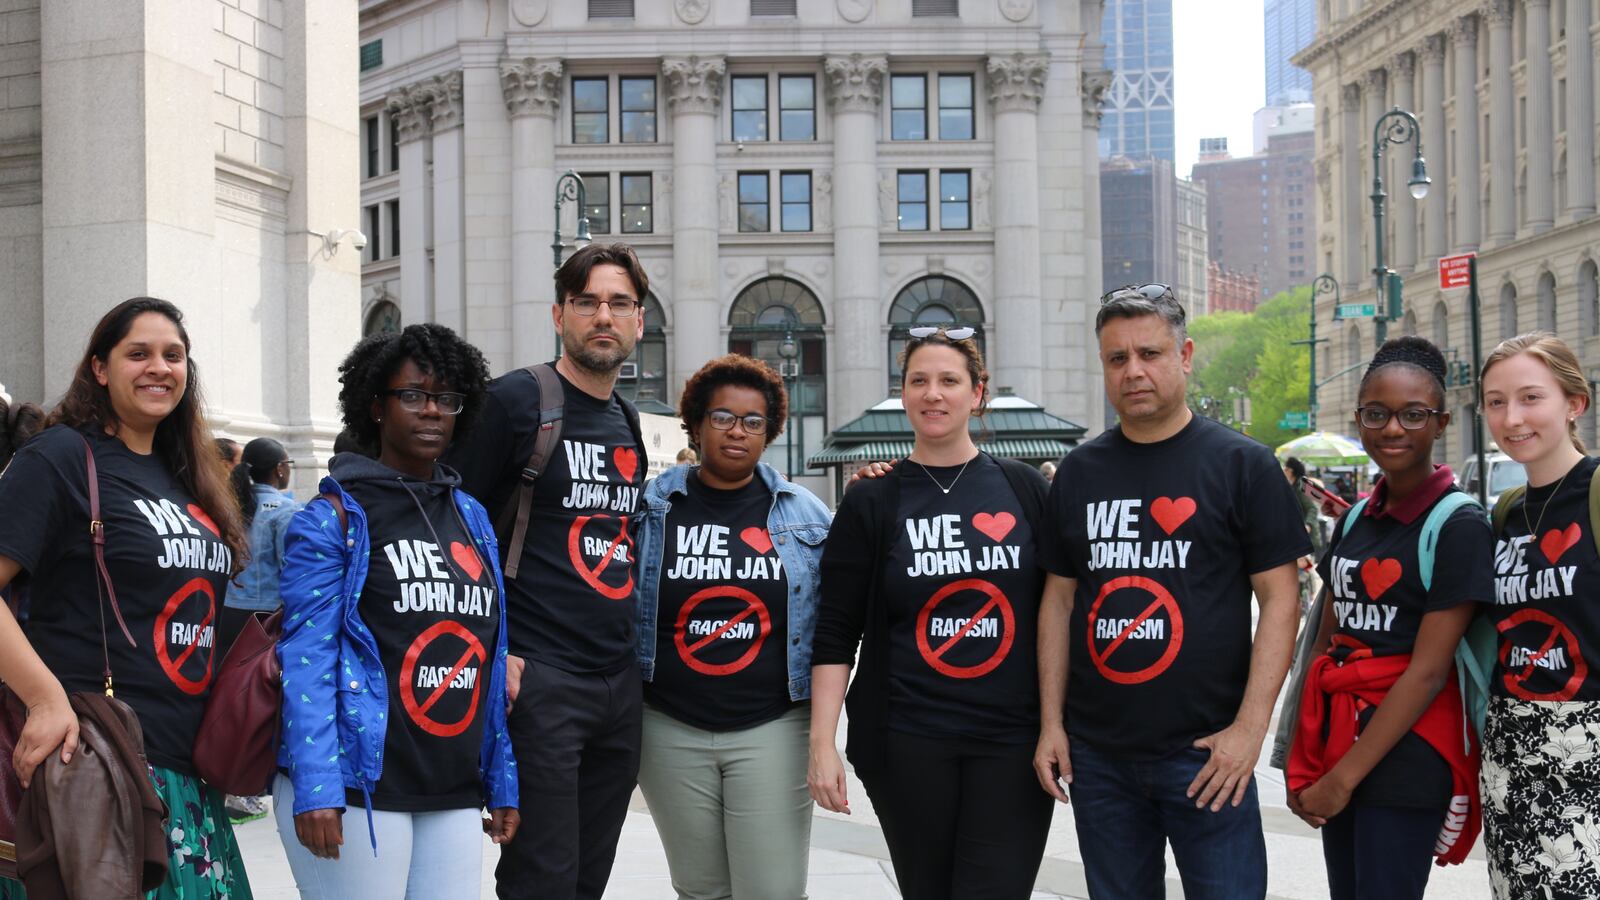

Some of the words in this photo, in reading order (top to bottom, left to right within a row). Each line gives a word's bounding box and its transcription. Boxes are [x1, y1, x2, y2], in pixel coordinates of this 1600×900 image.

[563, 440, 609, 481] WE
[562, 482, 610, 509] JOHN
[610, 484, 640, 513] JAY
[133, 498, 201, 536] WE
[905, 514, 965, 550] WE
[1086, 499, 1142, 540] WE
[676, 524, 730, 556] WE
[1088, 541, 1142, 571] JOHN
[1142, 540, 1192, 569] JAY
[1494, 534, 1533, 575] WE
[158, 538, 206, 570] JOHN
[207, 541, 232, 575] JAY
[384, 539, 450, 580] WE
[667, 556, 731, 580] JOHN
[736, 557, 782, 580] JAY
[907, 549, 972, 577] JOHN
[976, 545, 1021, 571] JAY
[393, 581, 455, 613] JOHN
[457, 584, 494, 617] JAY
[1529, 566, 1577, 600] JAY
[171, 622, 214, 648] RACISM
[689, 619, 755, 639] RACISM
[930, 617, 998, 638] RACISM
[1096, 618, 1164, 640] RACISM
[1510, 647, 1568, 671] RAISM
[417, 665, 477, 689] RACISM
